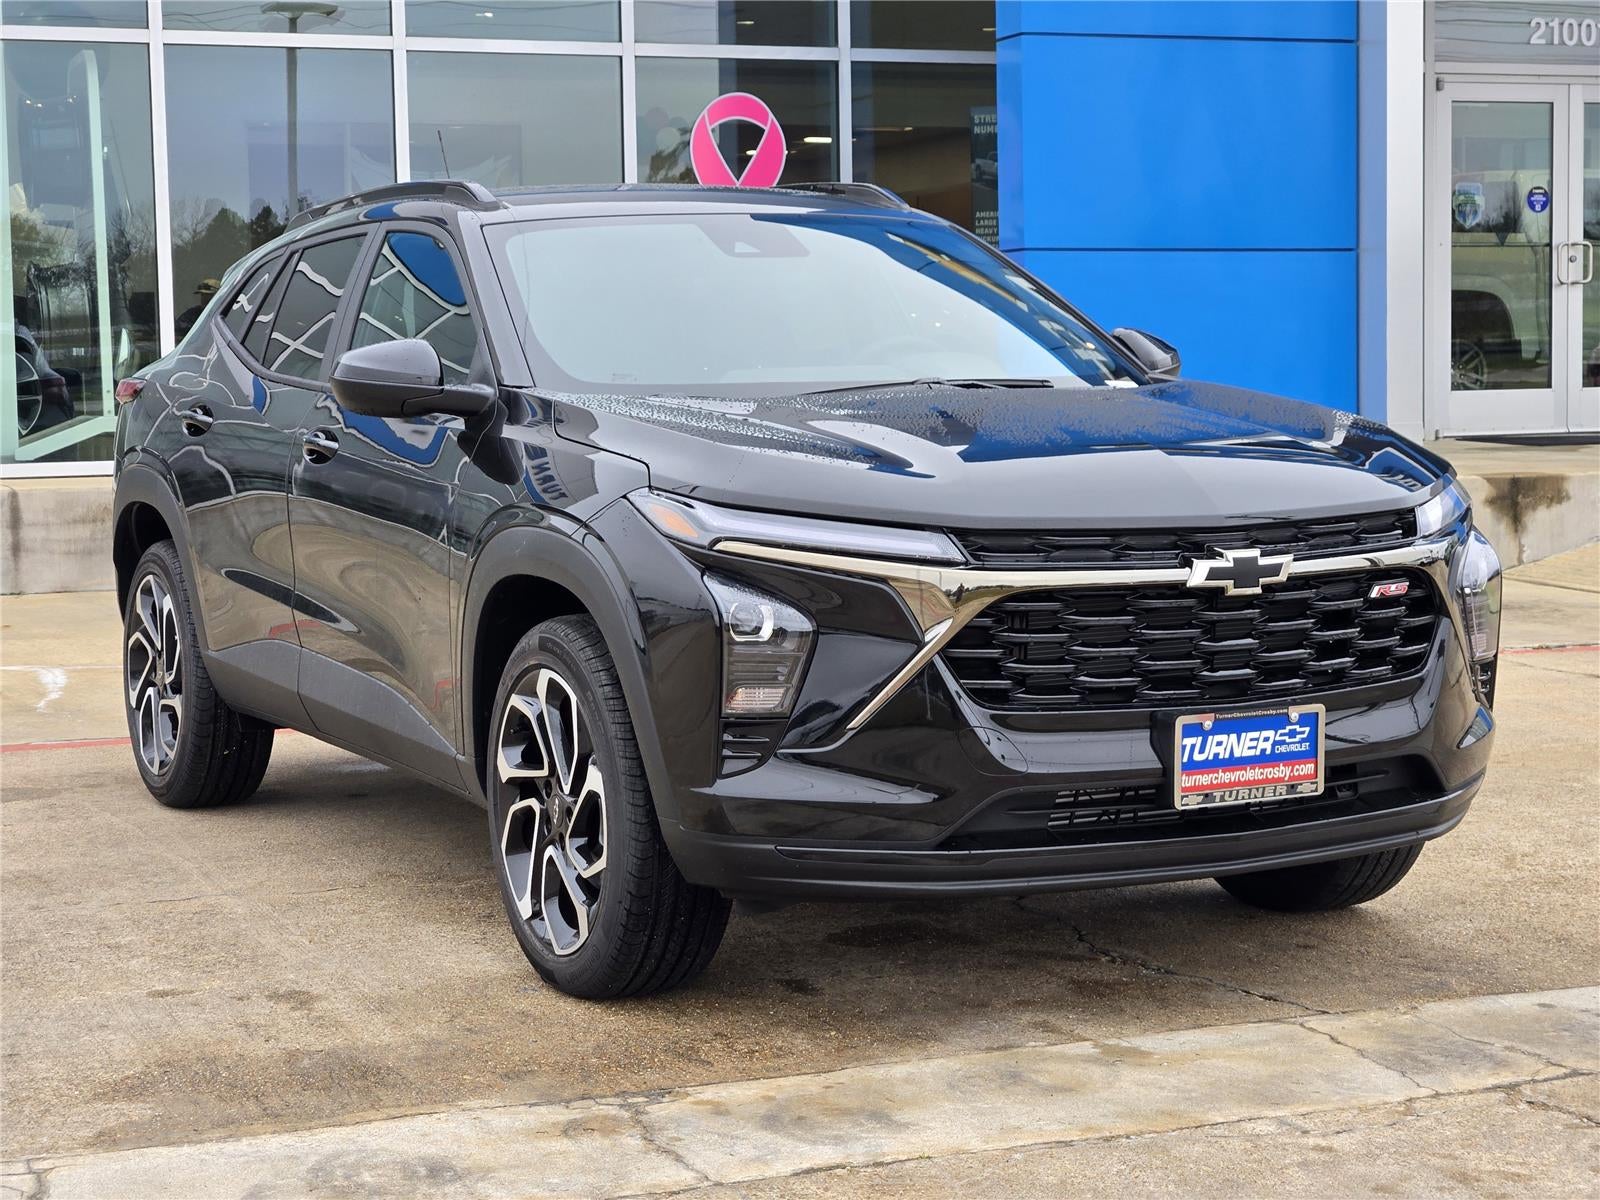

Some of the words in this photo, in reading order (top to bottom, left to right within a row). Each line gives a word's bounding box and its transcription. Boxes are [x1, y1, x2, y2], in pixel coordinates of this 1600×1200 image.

[1529, 17, 1600, 47] 2100
[1370, 581, 1409, 598] RS
[1216, 709, 1288, 718] TurnerChevroletCrosby.com
[1182, 730, 1275, 762] TURNER
[1181, 763, 1314, 787] turnerchevroletcrosby.com
[1213, 785, 1287, 803] TURNER
